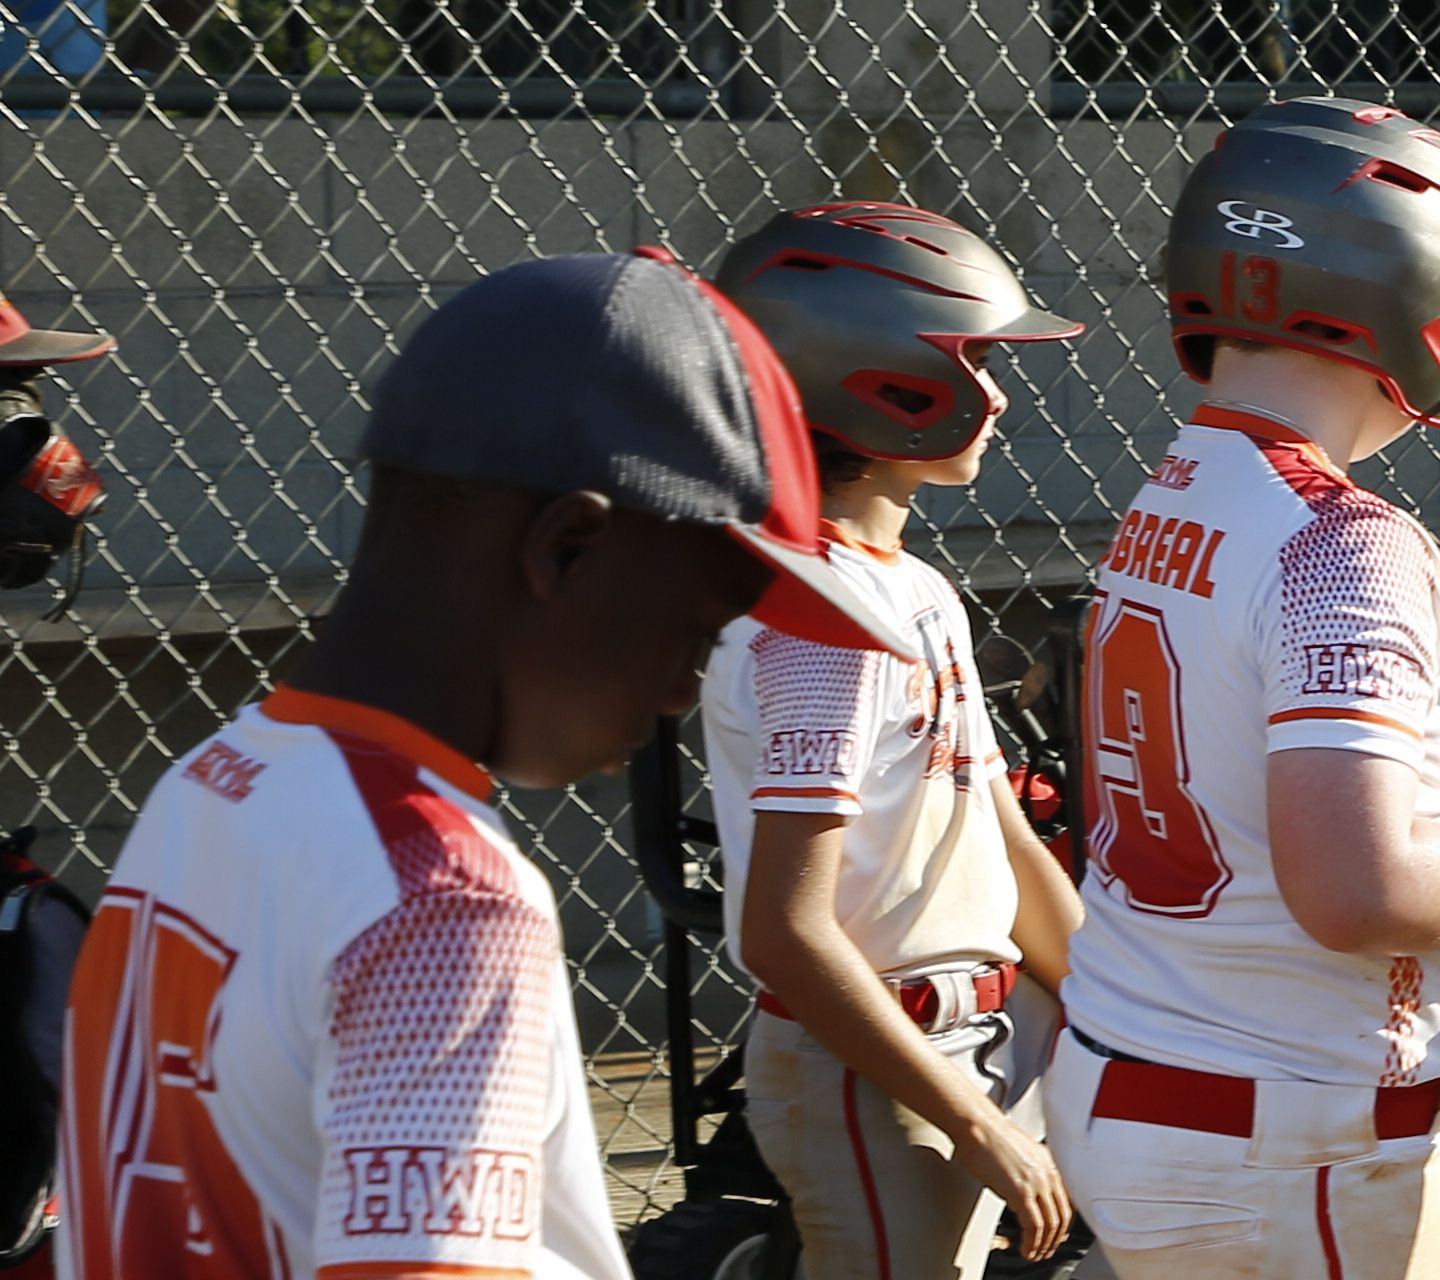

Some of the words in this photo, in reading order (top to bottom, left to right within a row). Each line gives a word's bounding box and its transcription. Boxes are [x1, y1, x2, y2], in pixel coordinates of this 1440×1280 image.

[1220, 249, 1283, 325] 13
[1101, 509, 1226, 600] GREAL
[344, 1146, 541, 1240] HWD
